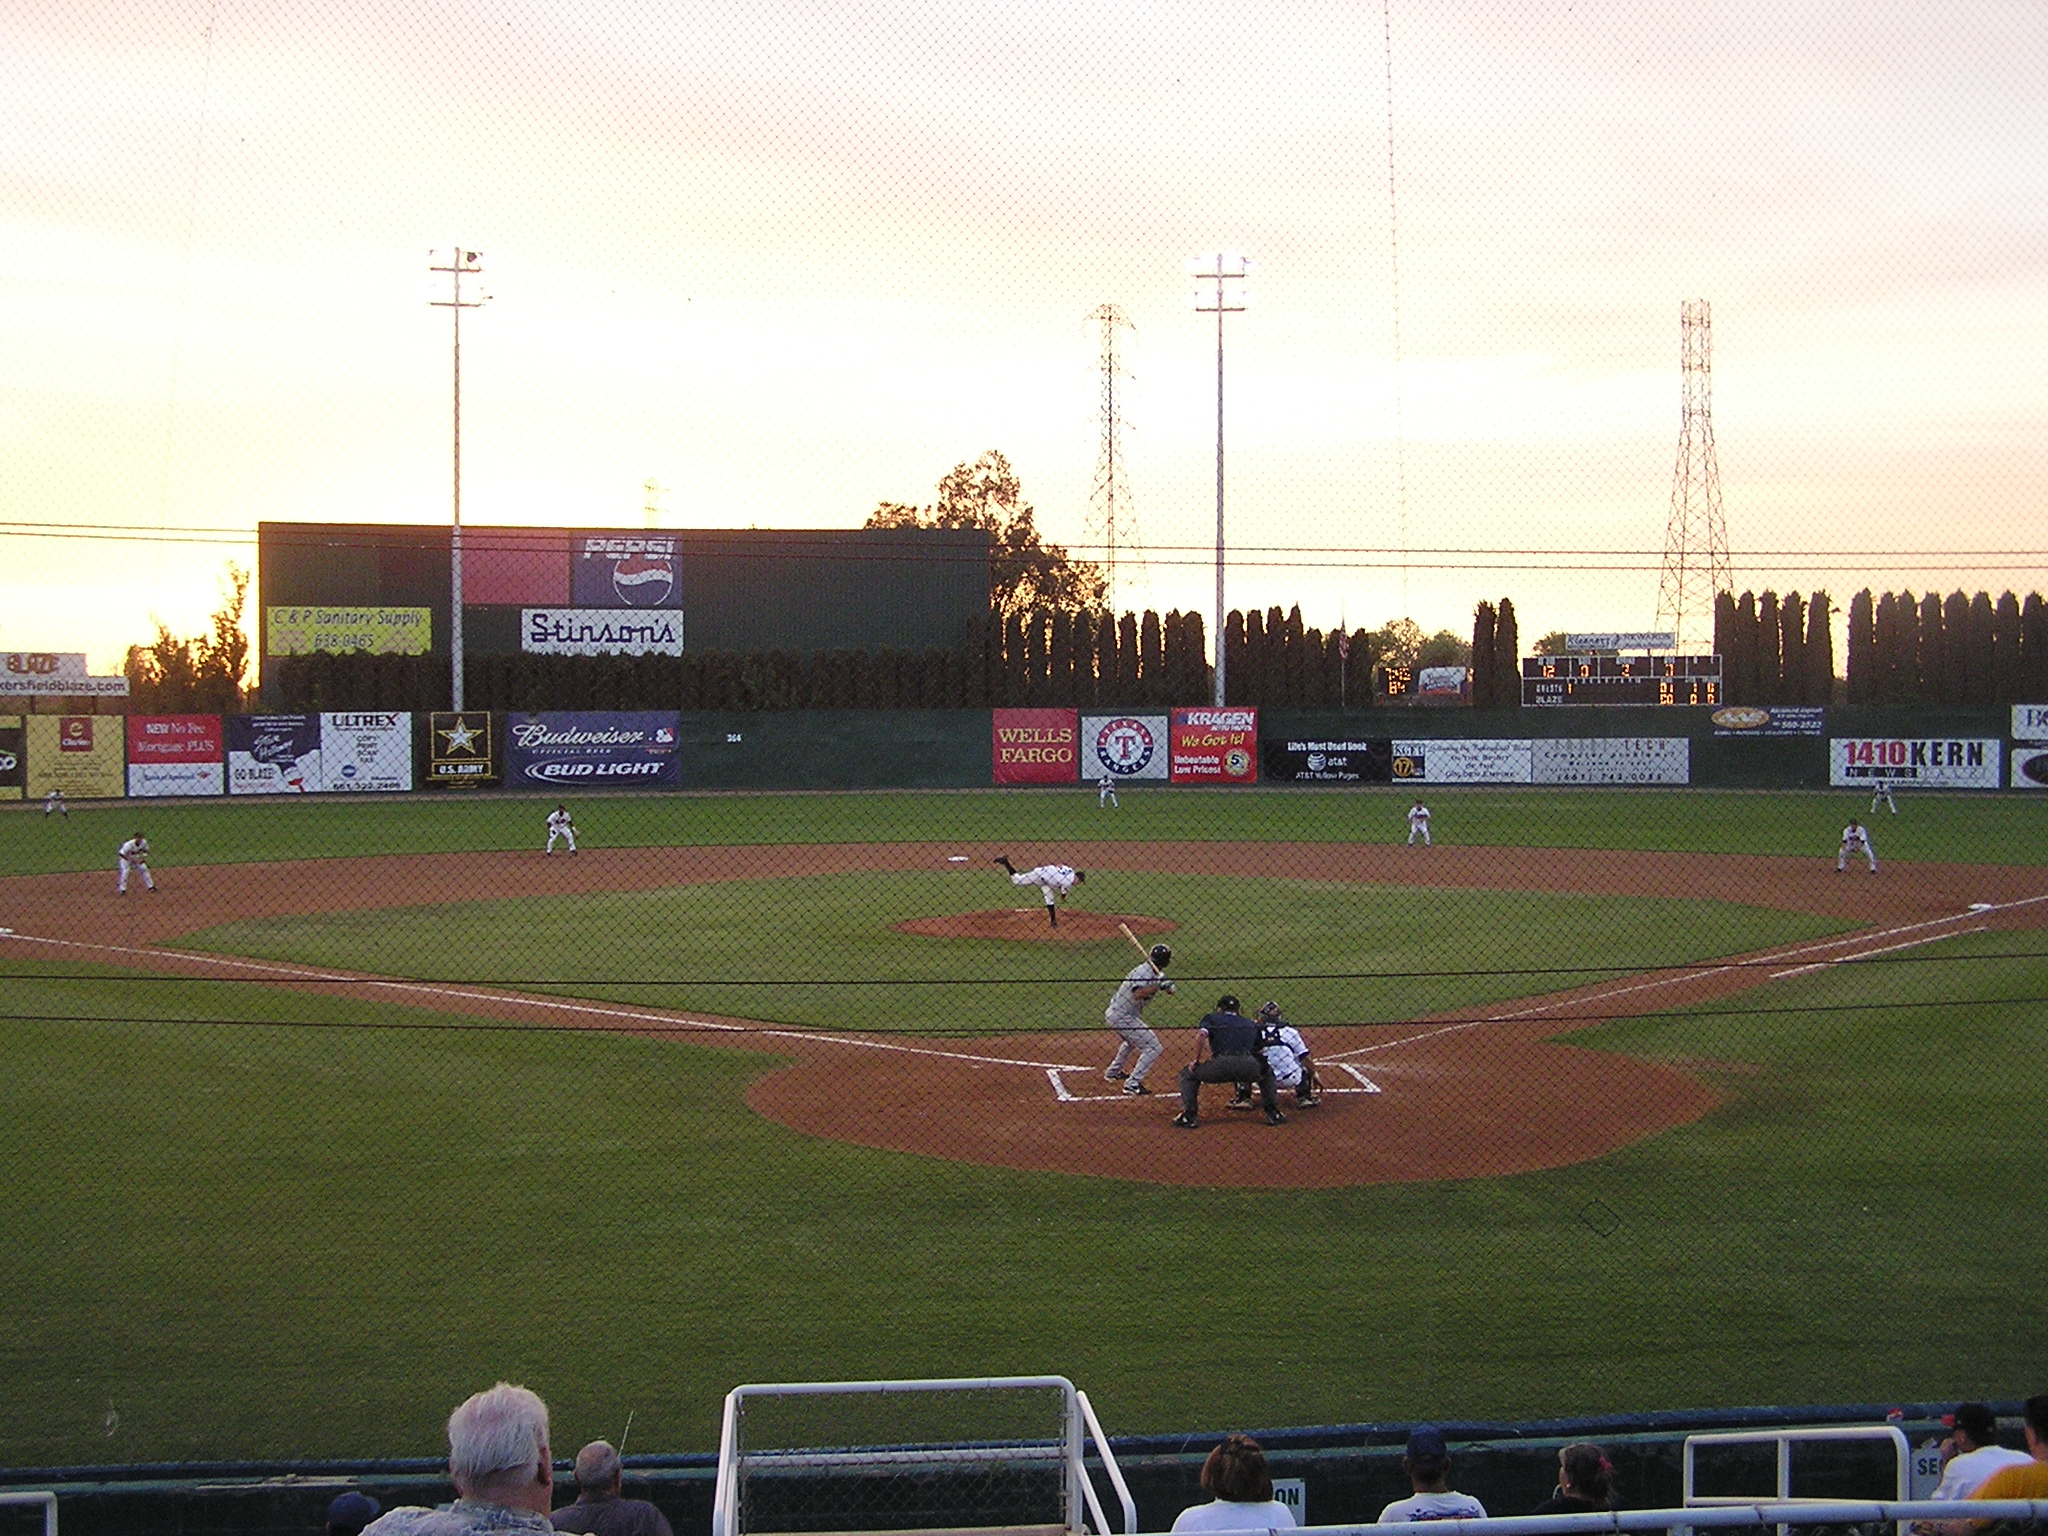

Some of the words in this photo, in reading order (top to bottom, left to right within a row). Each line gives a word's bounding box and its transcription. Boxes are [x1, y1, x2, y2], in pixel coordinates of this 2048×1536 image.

[584, 536, 676, 559] PEPSI
[274, 610, 284, 624] C
[289, 610, 297, 624] &
[303, 610, 311, 624] P
[315, 610, 373, 625] Sanitary
[378, 609, 422, 627] Supply
[531, 613, 676, 643] Stinson's
[314, 633, 374, 648] 638-0465
[332, 713, 400, 728] ULTREX
[1187, 712, 1255, 725] KRAGEN
[1104, 719, 1148, 735] TEXAS
[512, 723, 644, 747] Budweiser
[998, 728, 1073, 743] WELLS
[1182, 735, 1199, 747] We
[1202, 733, 1227, 746] Got
[1230, 732, 1245, 745] It!
[1115, 735, 1136, 760] T
[1308, 742, 1327, 751] Most
[1327, 742, 1346, 751] Used
[1347, 742, 1367, 751] Book
[1624, 740, 1665, 750] TECH
[1000, 748, 1073, 763] FARGO
[1174, 755, 1220, 764] Unbeatable
[1843, 741, 1906, 766] 1410
[1910, 742, 1983, 766] KERN
[439, 765, 457, 774] U.S.
[458, 764, 484, 774] ARMY
[543, 763, 594, 776] BUD
[595, 762, 662, 775] LIGHT
[1100, 750, 1150, 774] RANGERS
[1174, 765, 1191, 774] Low
[1193, 765, 1221, 774] Prices!
[1850, 768, 1914, 777] NEWS
